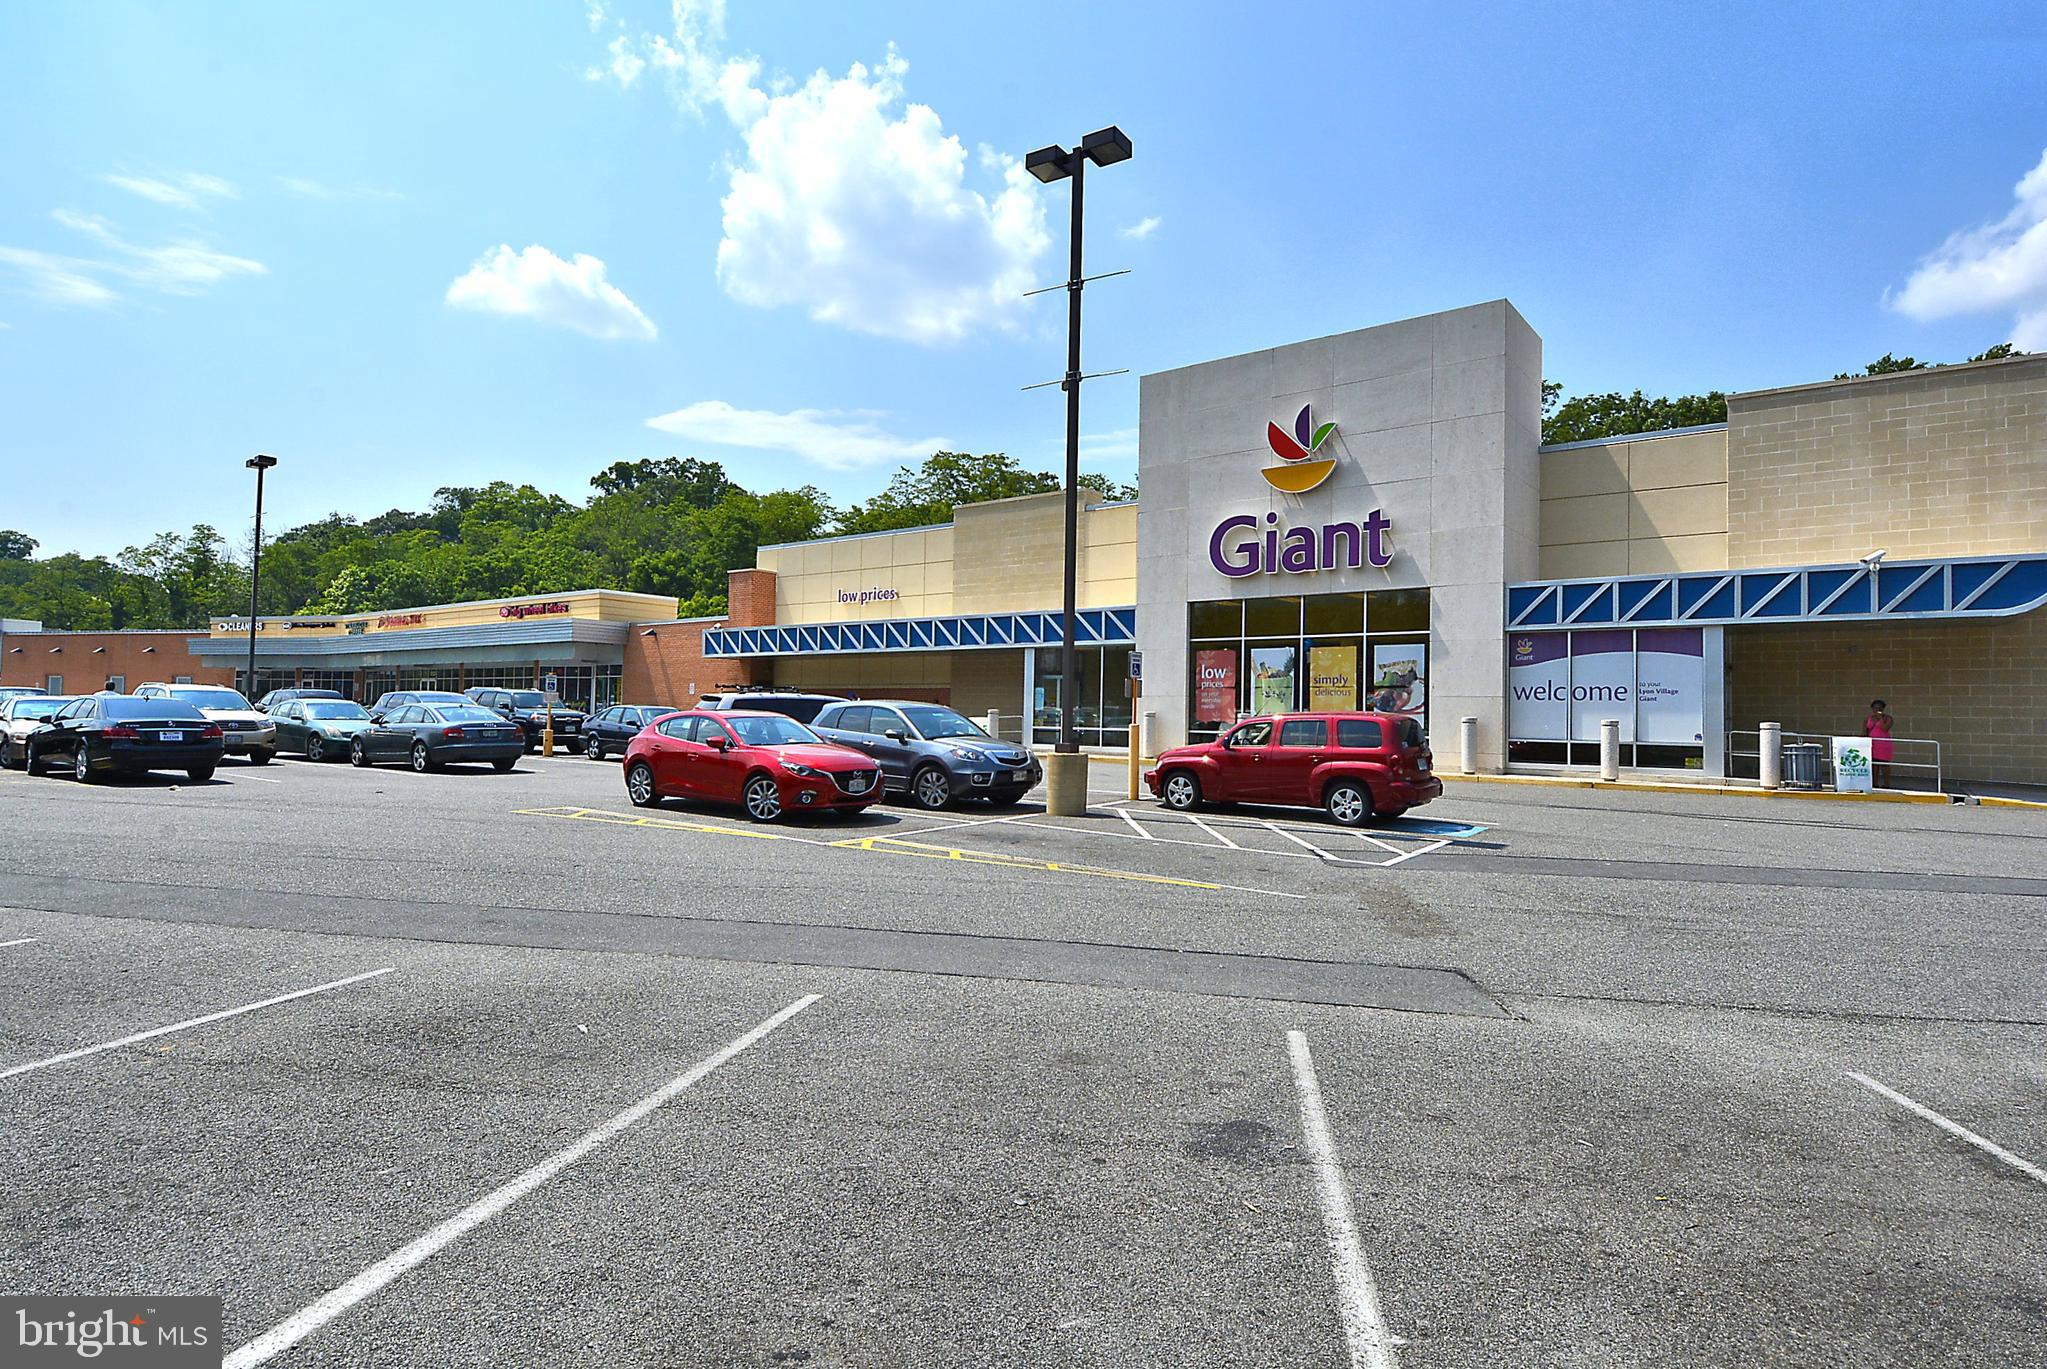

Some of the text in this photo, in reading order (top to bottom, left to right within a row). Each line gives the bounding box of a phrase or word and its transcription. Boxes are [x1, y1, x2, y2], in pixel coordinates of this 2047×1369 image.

[1209, 508, 1395, 578] Giant
[838, 587, 896, 605] low prices
[1201, 664, 1227, 679] low
[1201, 680, 1224, 690] prices
[1313, 674, 1349, 687] simply
[1315, 688, 1352, 697] delicious
[1513, 679, 1628, 702] welcome
